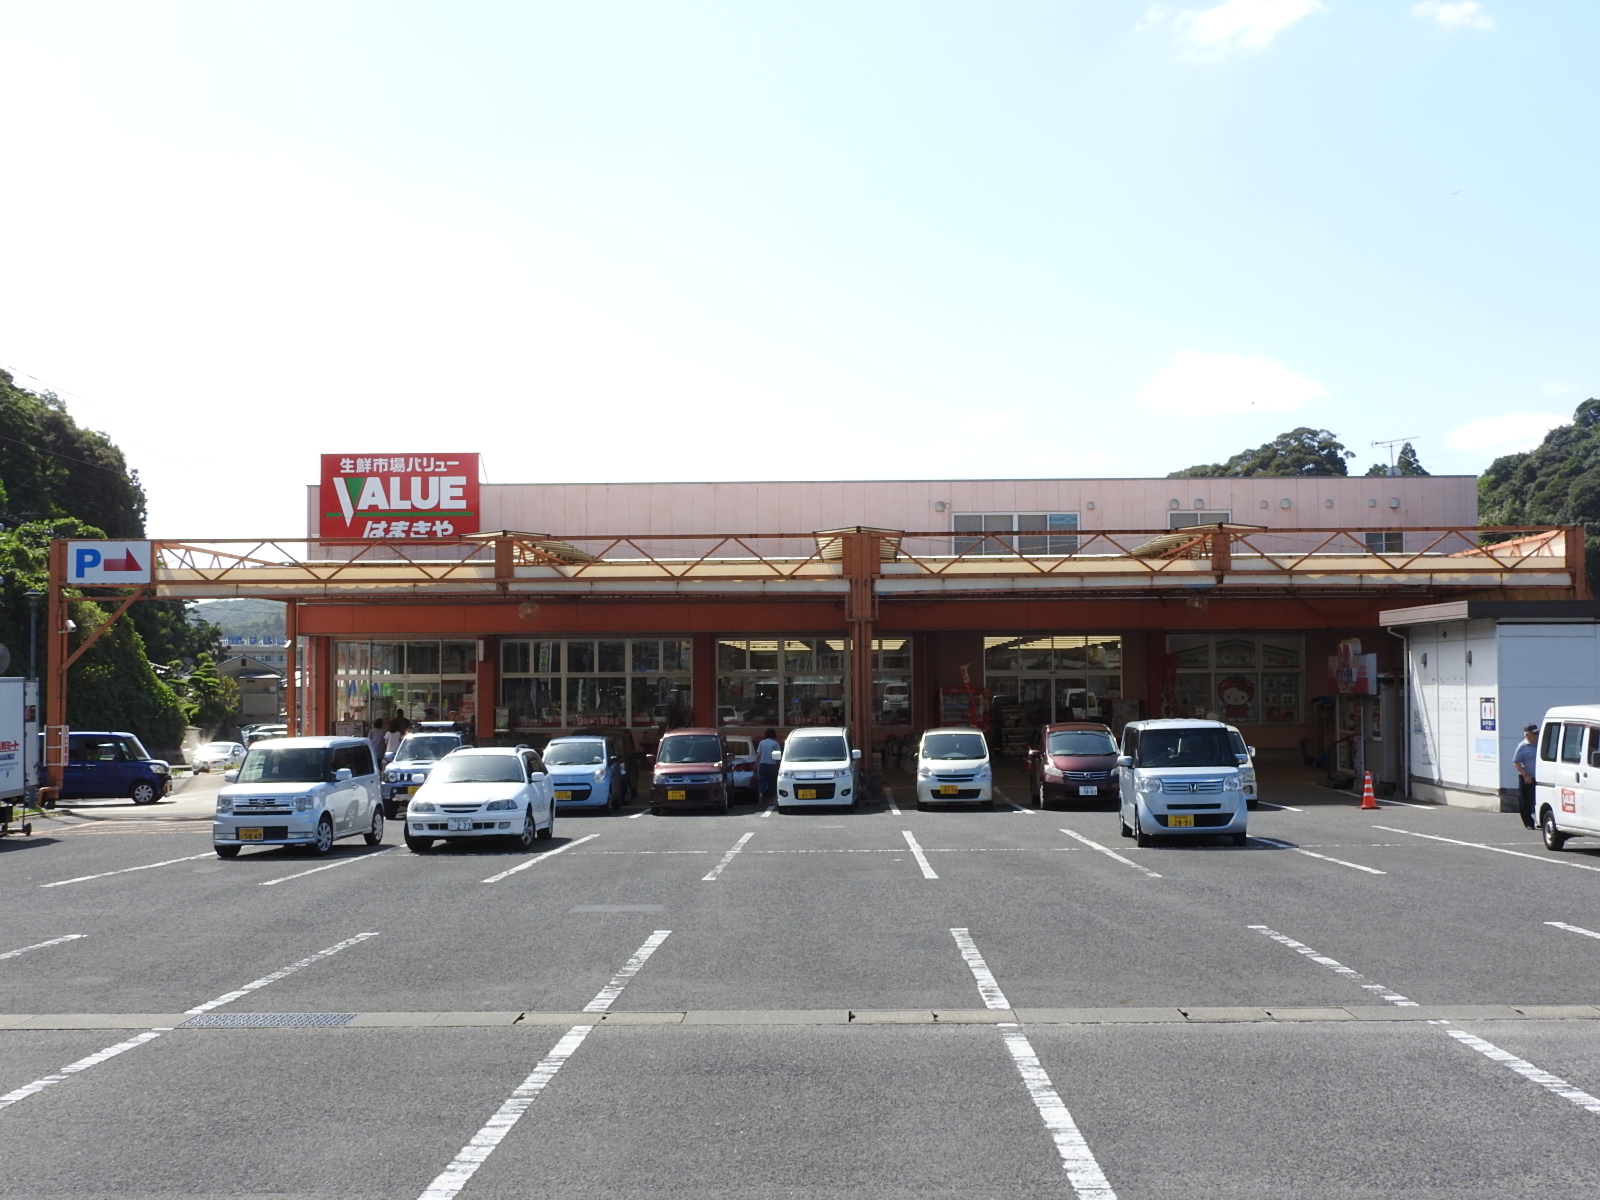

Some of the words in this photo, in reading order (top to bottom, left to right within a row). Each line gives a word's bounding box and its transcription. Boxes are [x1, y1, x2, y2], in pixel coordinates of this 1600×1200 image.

[340, 457, 460, 474] 生鮮市場バリュー
[332, 475, 467, 528] VALUE
[362, 520, 454, 538] はまきや
[75, 548, 102, 578] P
[1173, 819, 1192, 827] 28-91
